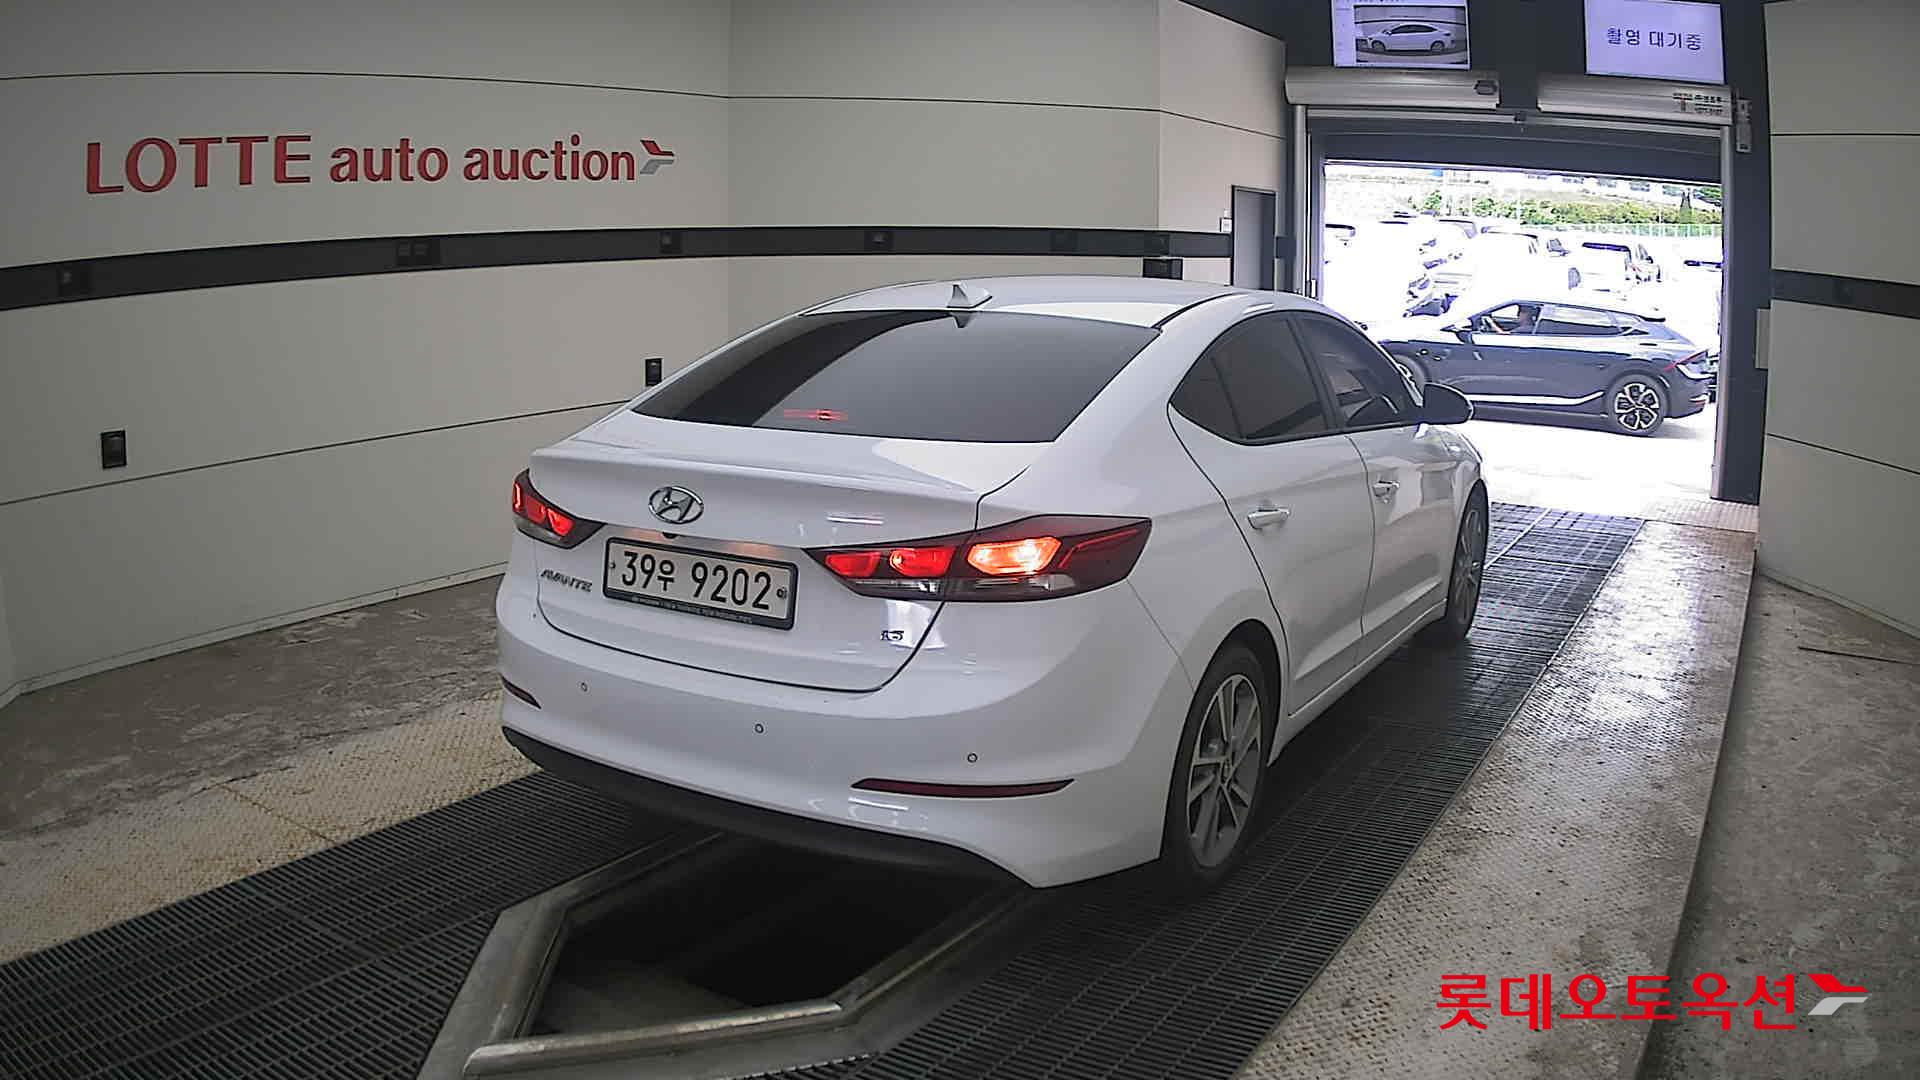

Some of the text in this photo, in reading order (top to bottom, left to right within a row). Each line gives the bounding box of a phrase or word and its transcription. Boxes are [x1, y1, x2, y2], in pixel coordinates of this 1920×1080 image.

[1648, 31, 1701, 51] 대기중
[86, 134, 636, 195] LOTTE auto auction
[621, 550, 675, 592] 39우
[690, 561, 772, 611] 9202
